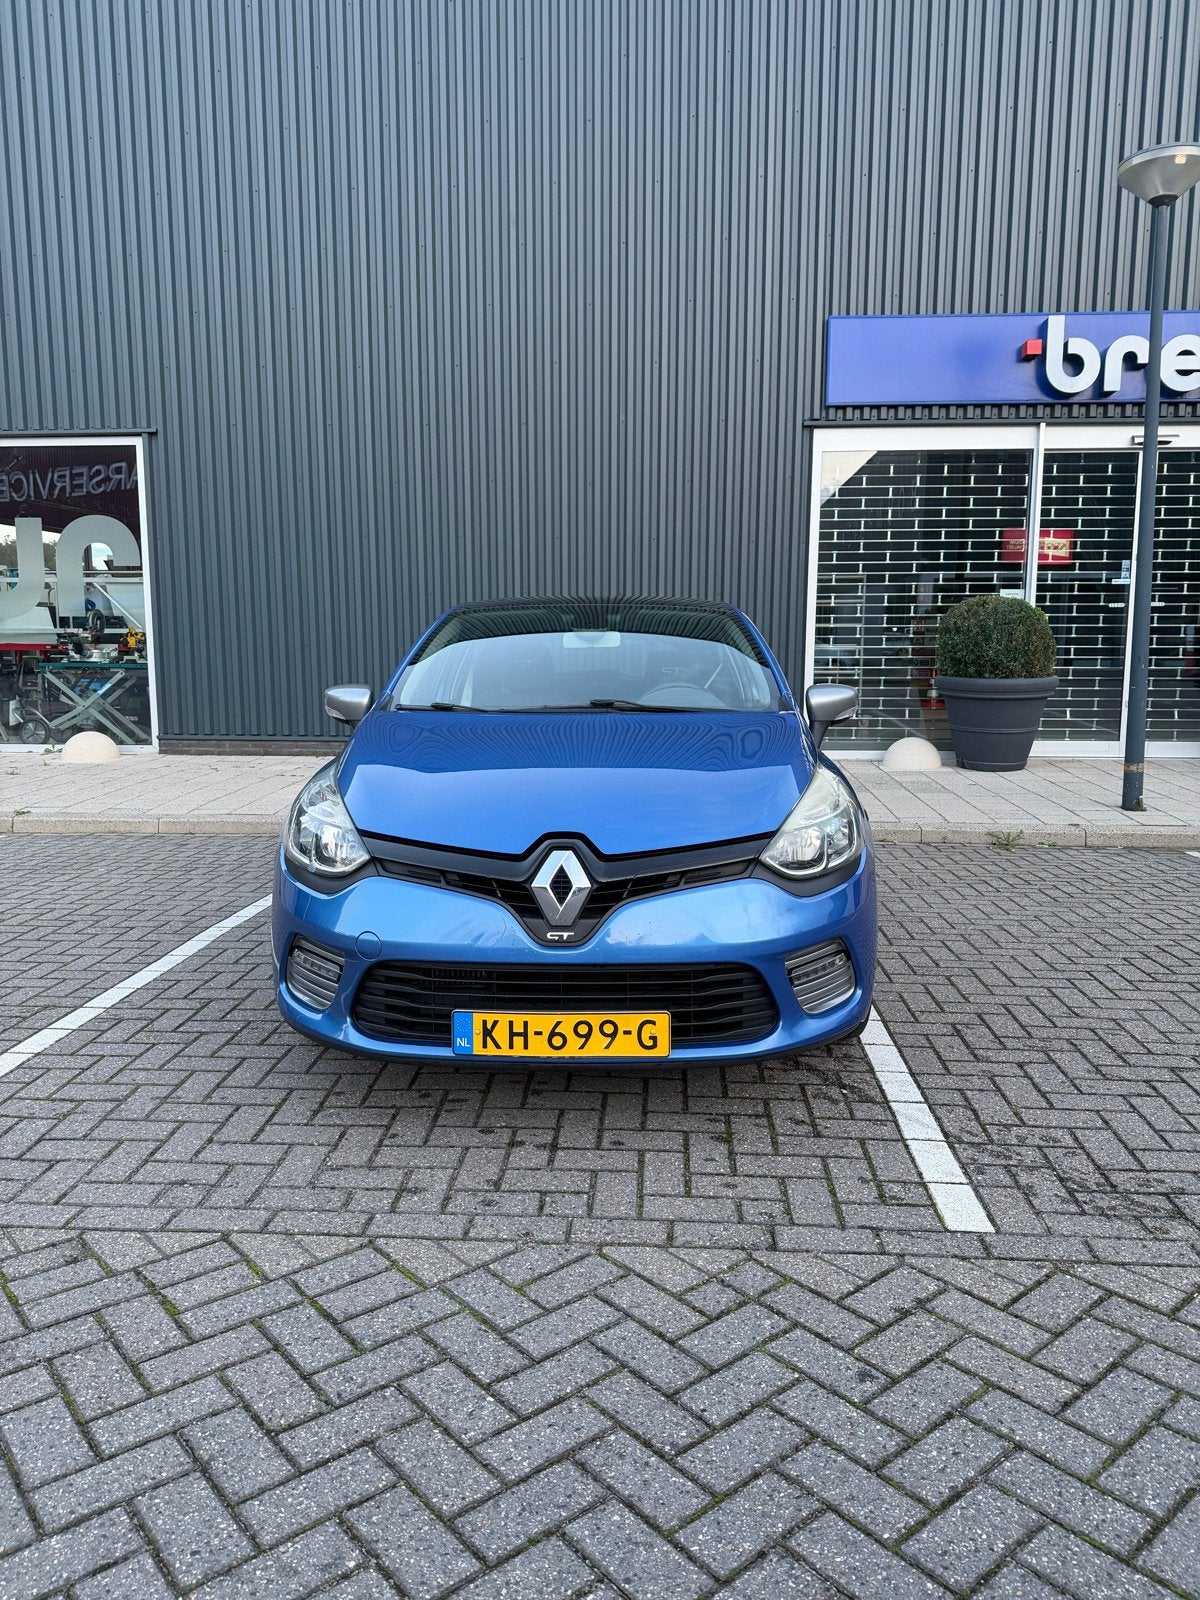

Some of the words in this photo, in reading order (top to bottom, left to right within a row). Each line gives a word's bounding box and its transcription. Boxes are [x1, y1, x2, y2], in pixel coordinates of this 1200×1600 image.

[1046, 315, 1200, 394] bre
[546, 931, 575, 941] GT
[456, 1037, 471, 1047] NL
[481, 1019, 658, 1051] KH-699-G
